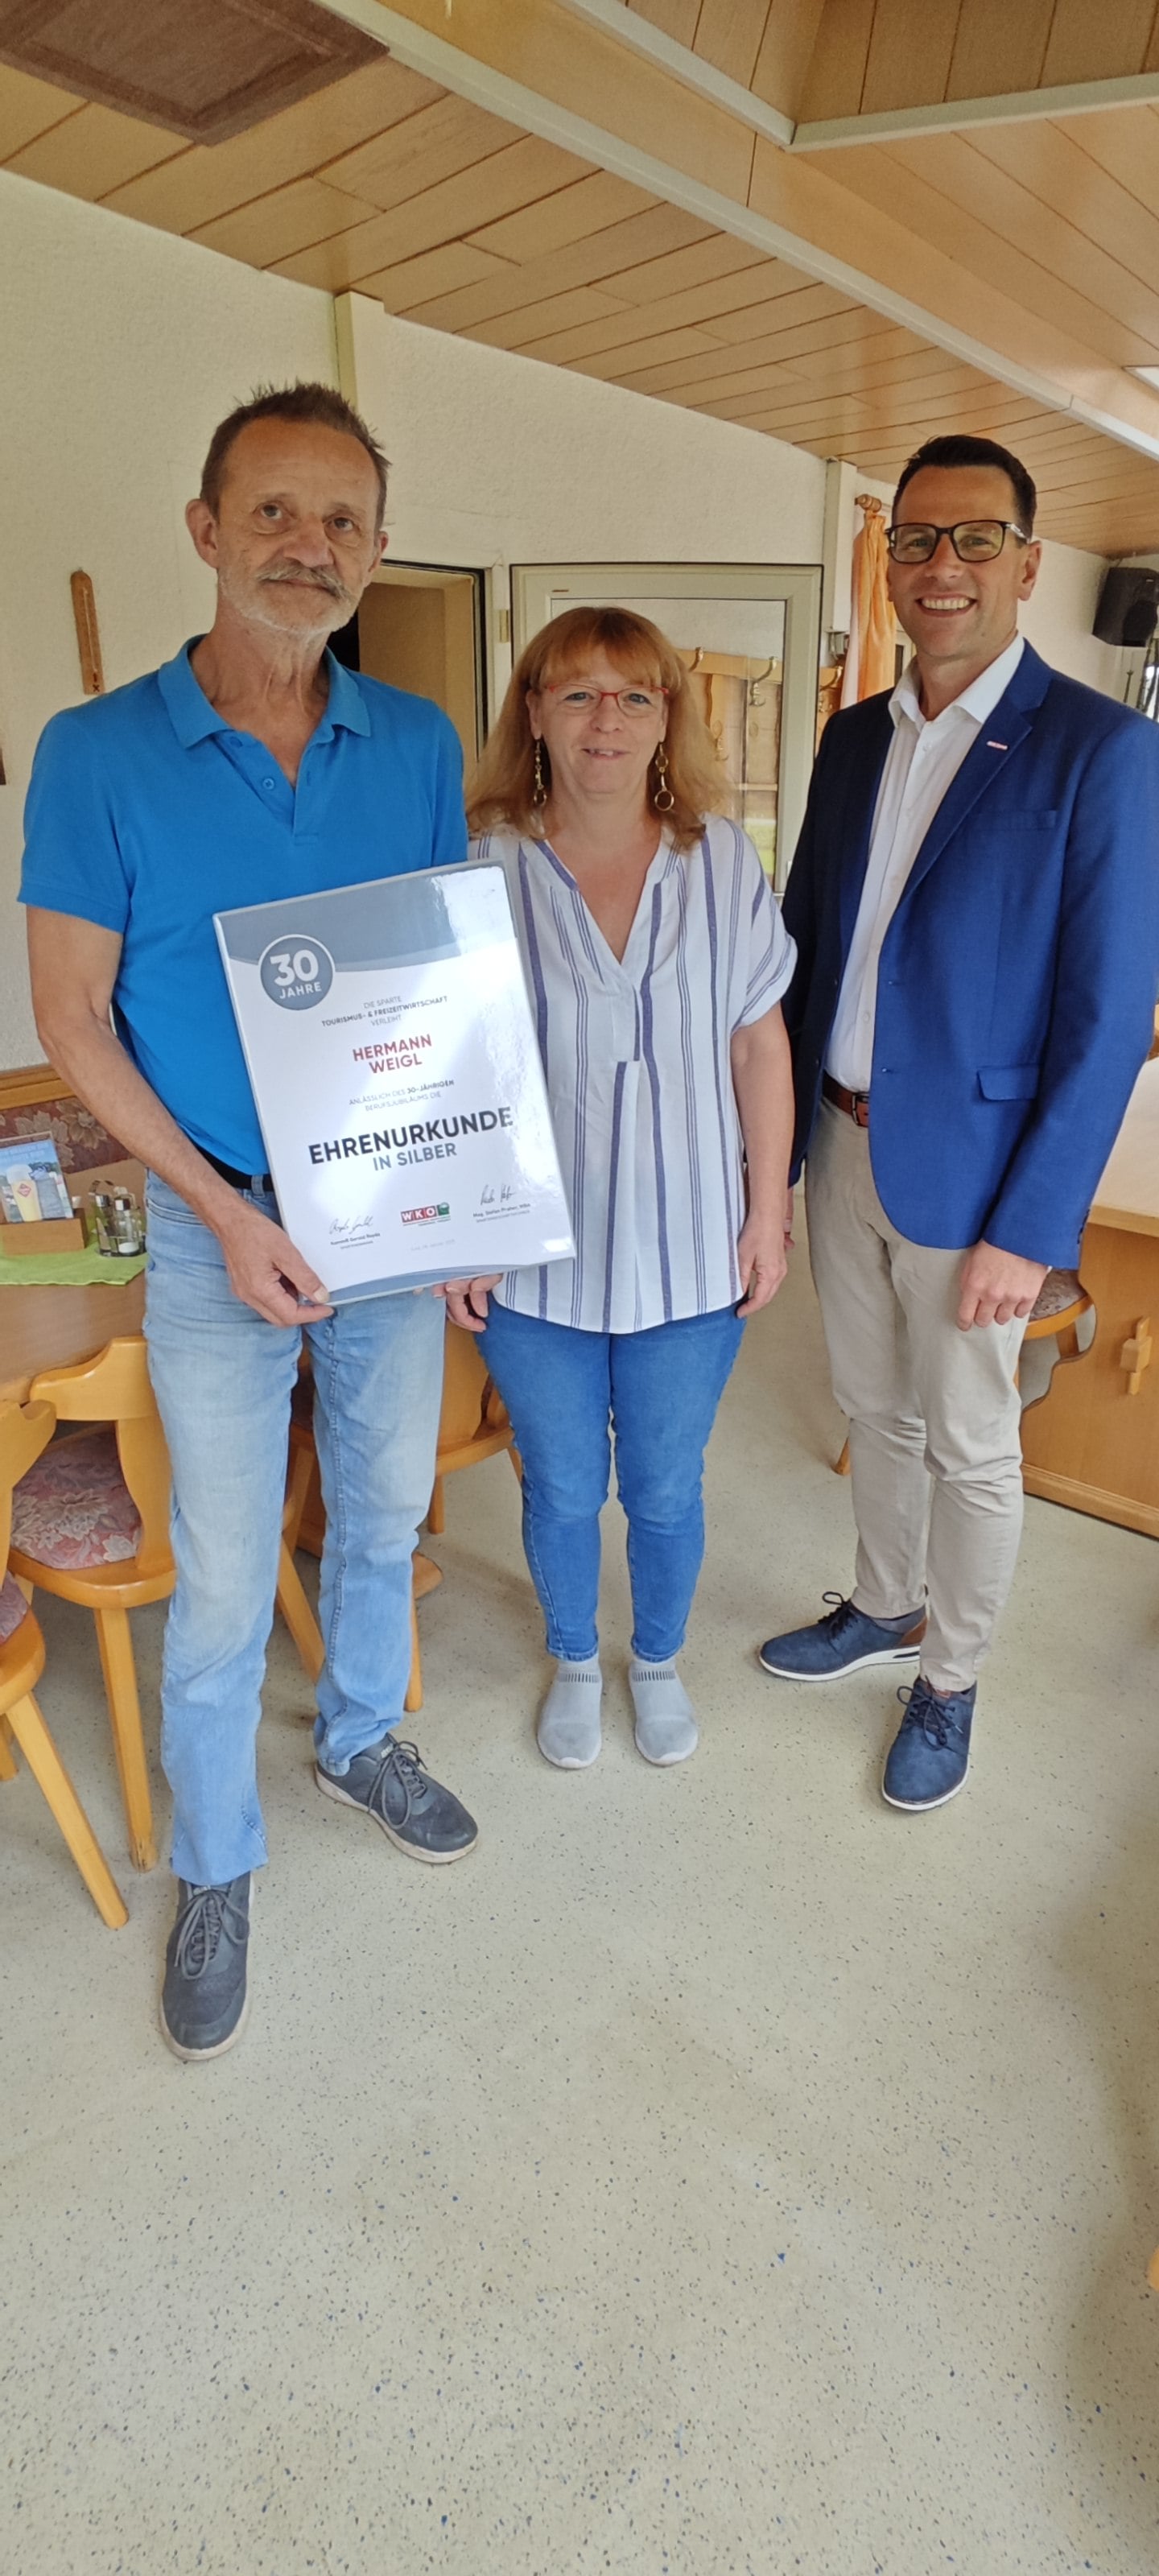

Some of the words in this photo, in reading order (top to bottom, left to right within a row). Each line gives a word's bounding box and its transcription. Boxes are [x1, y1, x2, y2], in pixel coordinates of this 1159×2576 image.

[270, 949, 319, 987] 30
[278, 981, 323, 1000] JAHRE
[363, 1001, 375, 1009] DIE
[376, 995, 402, 1007] SPARTE
[321, 1012, 366, 1027] TOURISMUS-
[373, 995, 448, 1017] FREIZEITWIRTSCHAFT
[370, 1013, 402, 1026] VERLEIHT
[353, 1034, 432, 1062] HERMANN
[369, 1053, 423, 1074] WEIGL
[308, 1106, 514, 1165] EHRENURKUNDE
[373, 1154, 393, 1171] IN
[397, 1142, 458, 1167] SILBER
[402, 1207, 435, 1222] WKO
